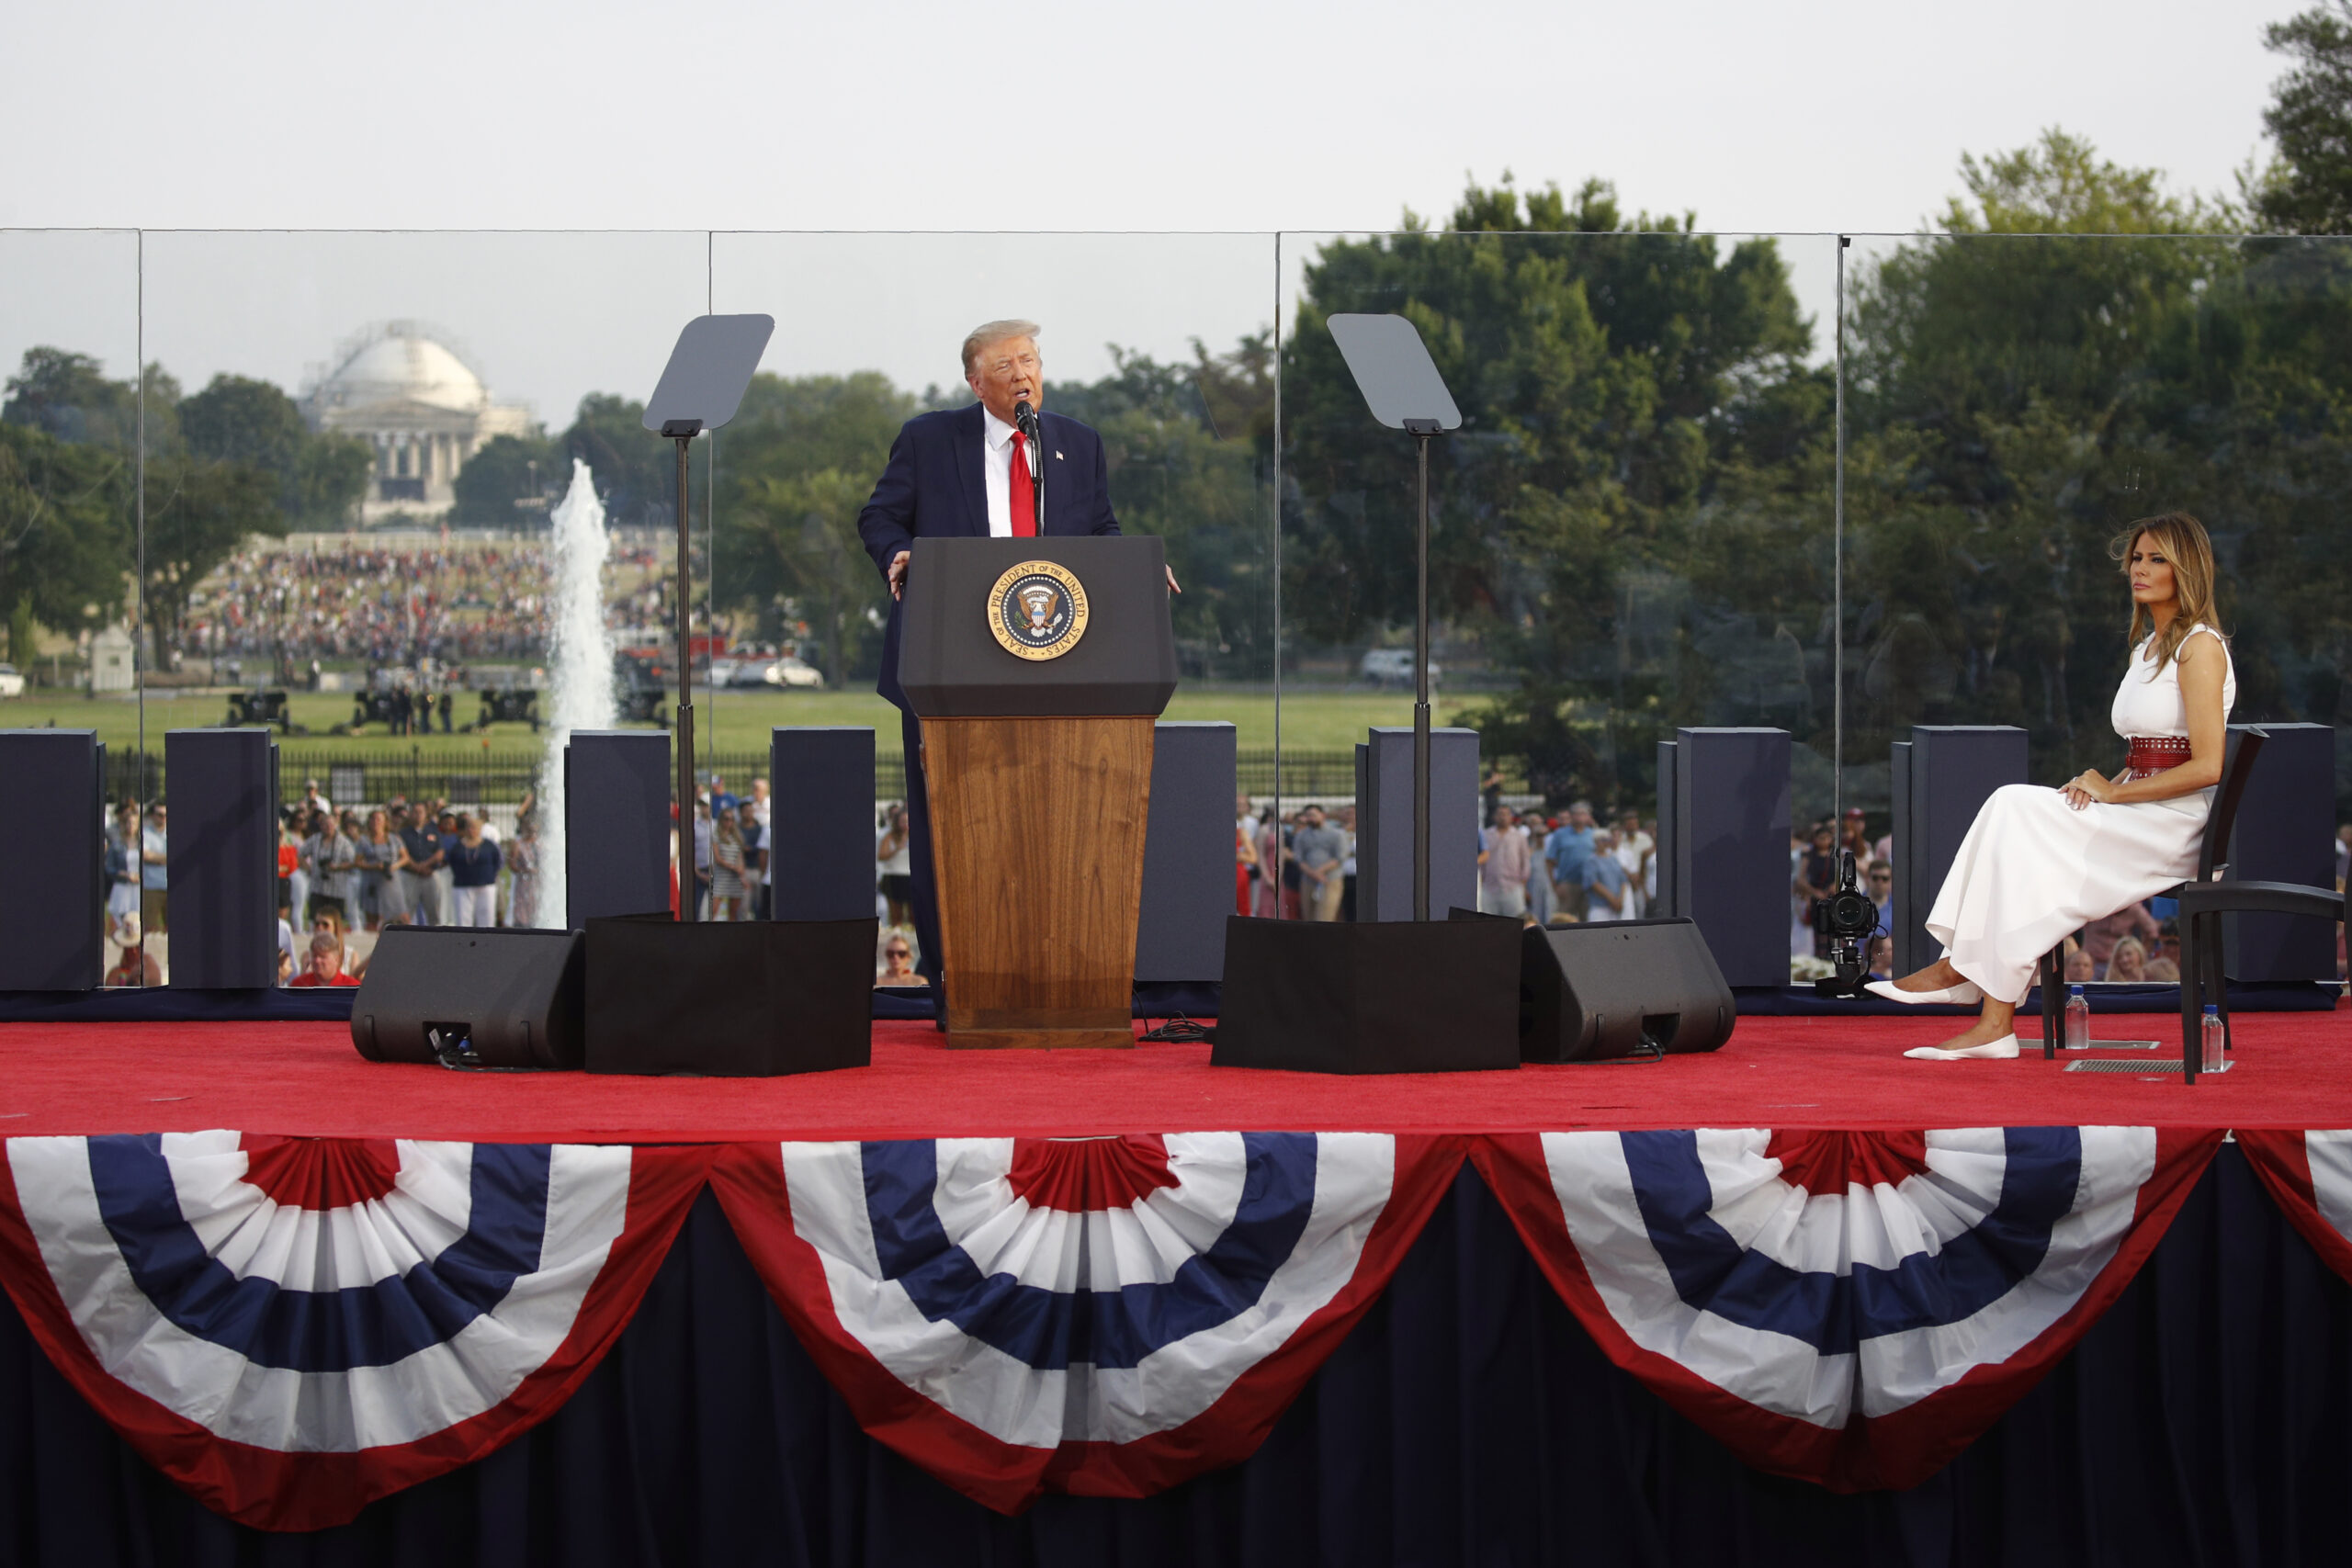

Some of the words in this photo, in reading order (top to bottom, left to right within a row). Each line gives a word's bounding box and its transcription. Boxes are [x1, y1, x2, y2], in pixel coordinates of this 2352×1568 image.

[1050, 567, 1064, 578] THE
[991, 564, 1035, 608] PRESIDENT
[1064, 576, 1085, 617] UNITED
[992, 611, 1001, 625] THE
[996, 626, 1004, 636] OF
[1046, 626, 1080, 656] STATES
[1003, 634, 1029, 656] SEAL
